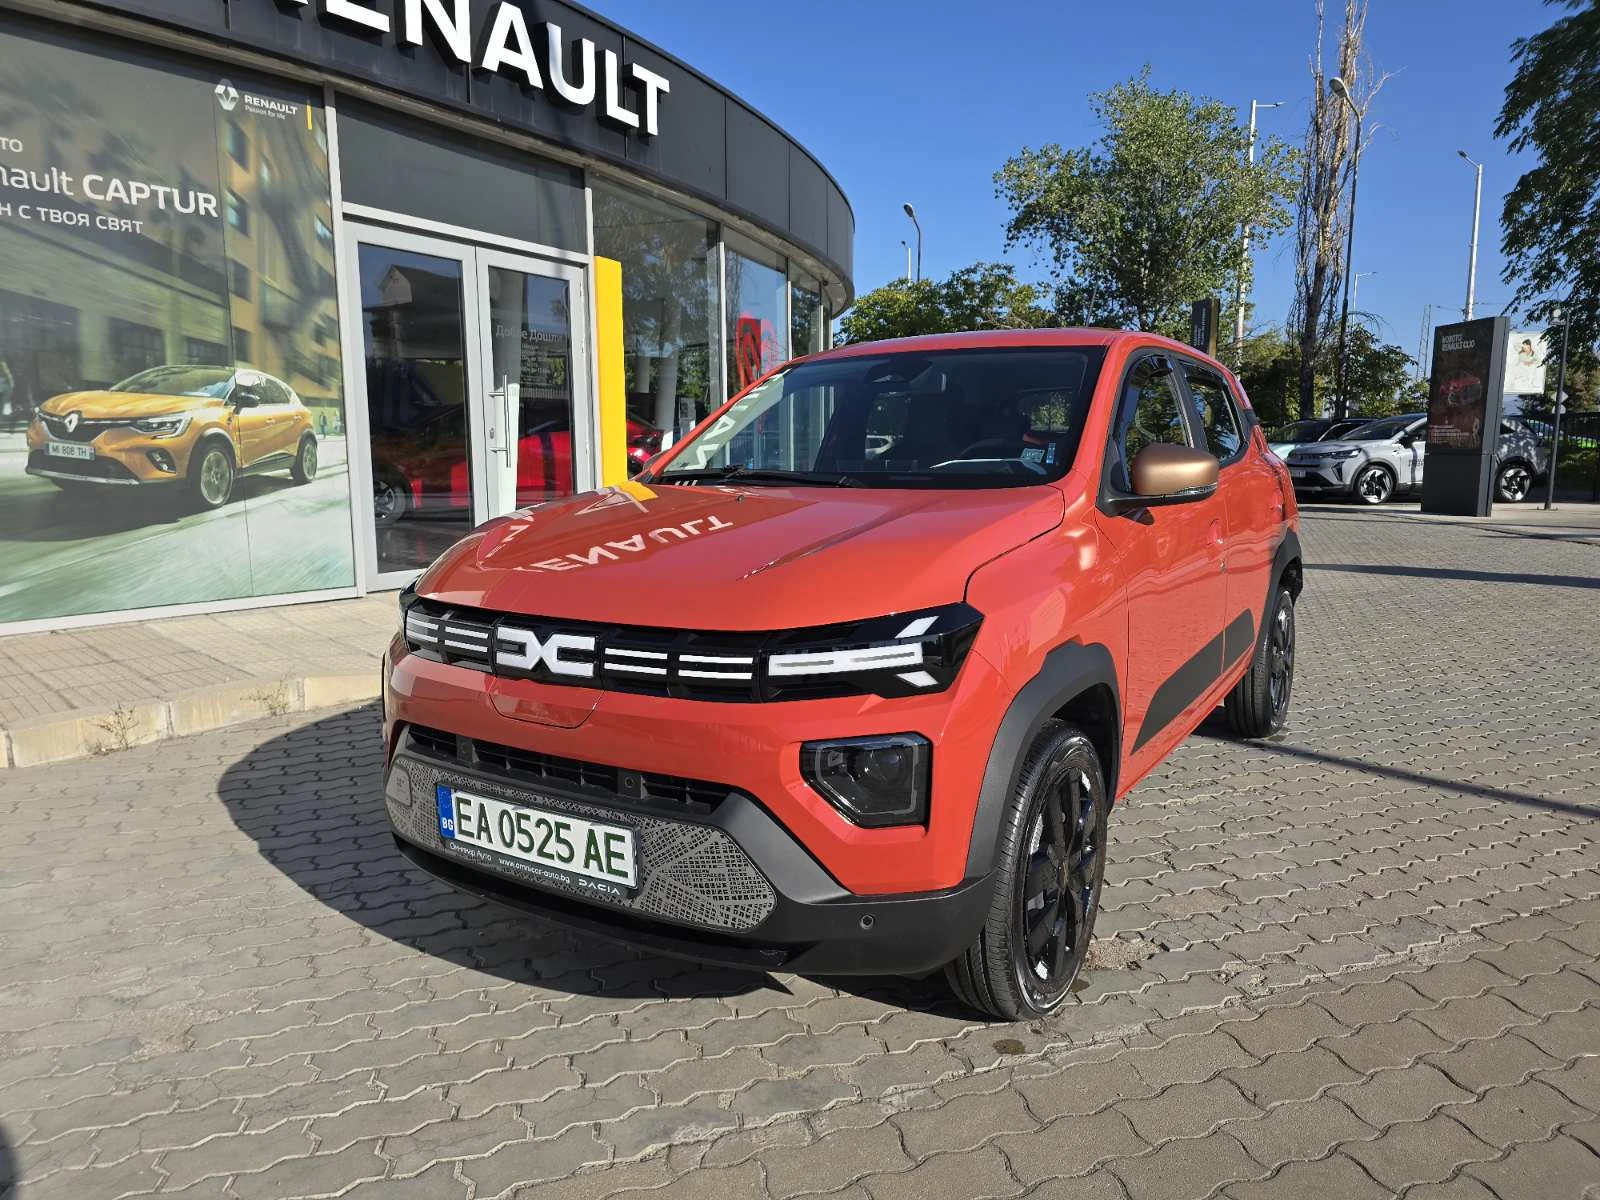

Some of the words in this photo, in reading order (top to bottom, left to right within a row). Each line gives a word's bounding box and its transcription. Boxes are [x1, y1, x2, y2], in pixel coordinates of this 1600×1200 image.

[244, 94, 298, 115] RENAULT
[82, 174, 219, 218] CAPTUR
[18, 205, 32, 219] С
[36, 207, 90, 227] ТВОЯ
[95, 215, 144, 234] СВЯТ
[442, 817, 454, 830] BG
[455, 796, 494, 844] EA
[498, 809, 575, 864] 0525
[583, 829, 629, 878] AE
[578, 878, 621, 896] DACIA
